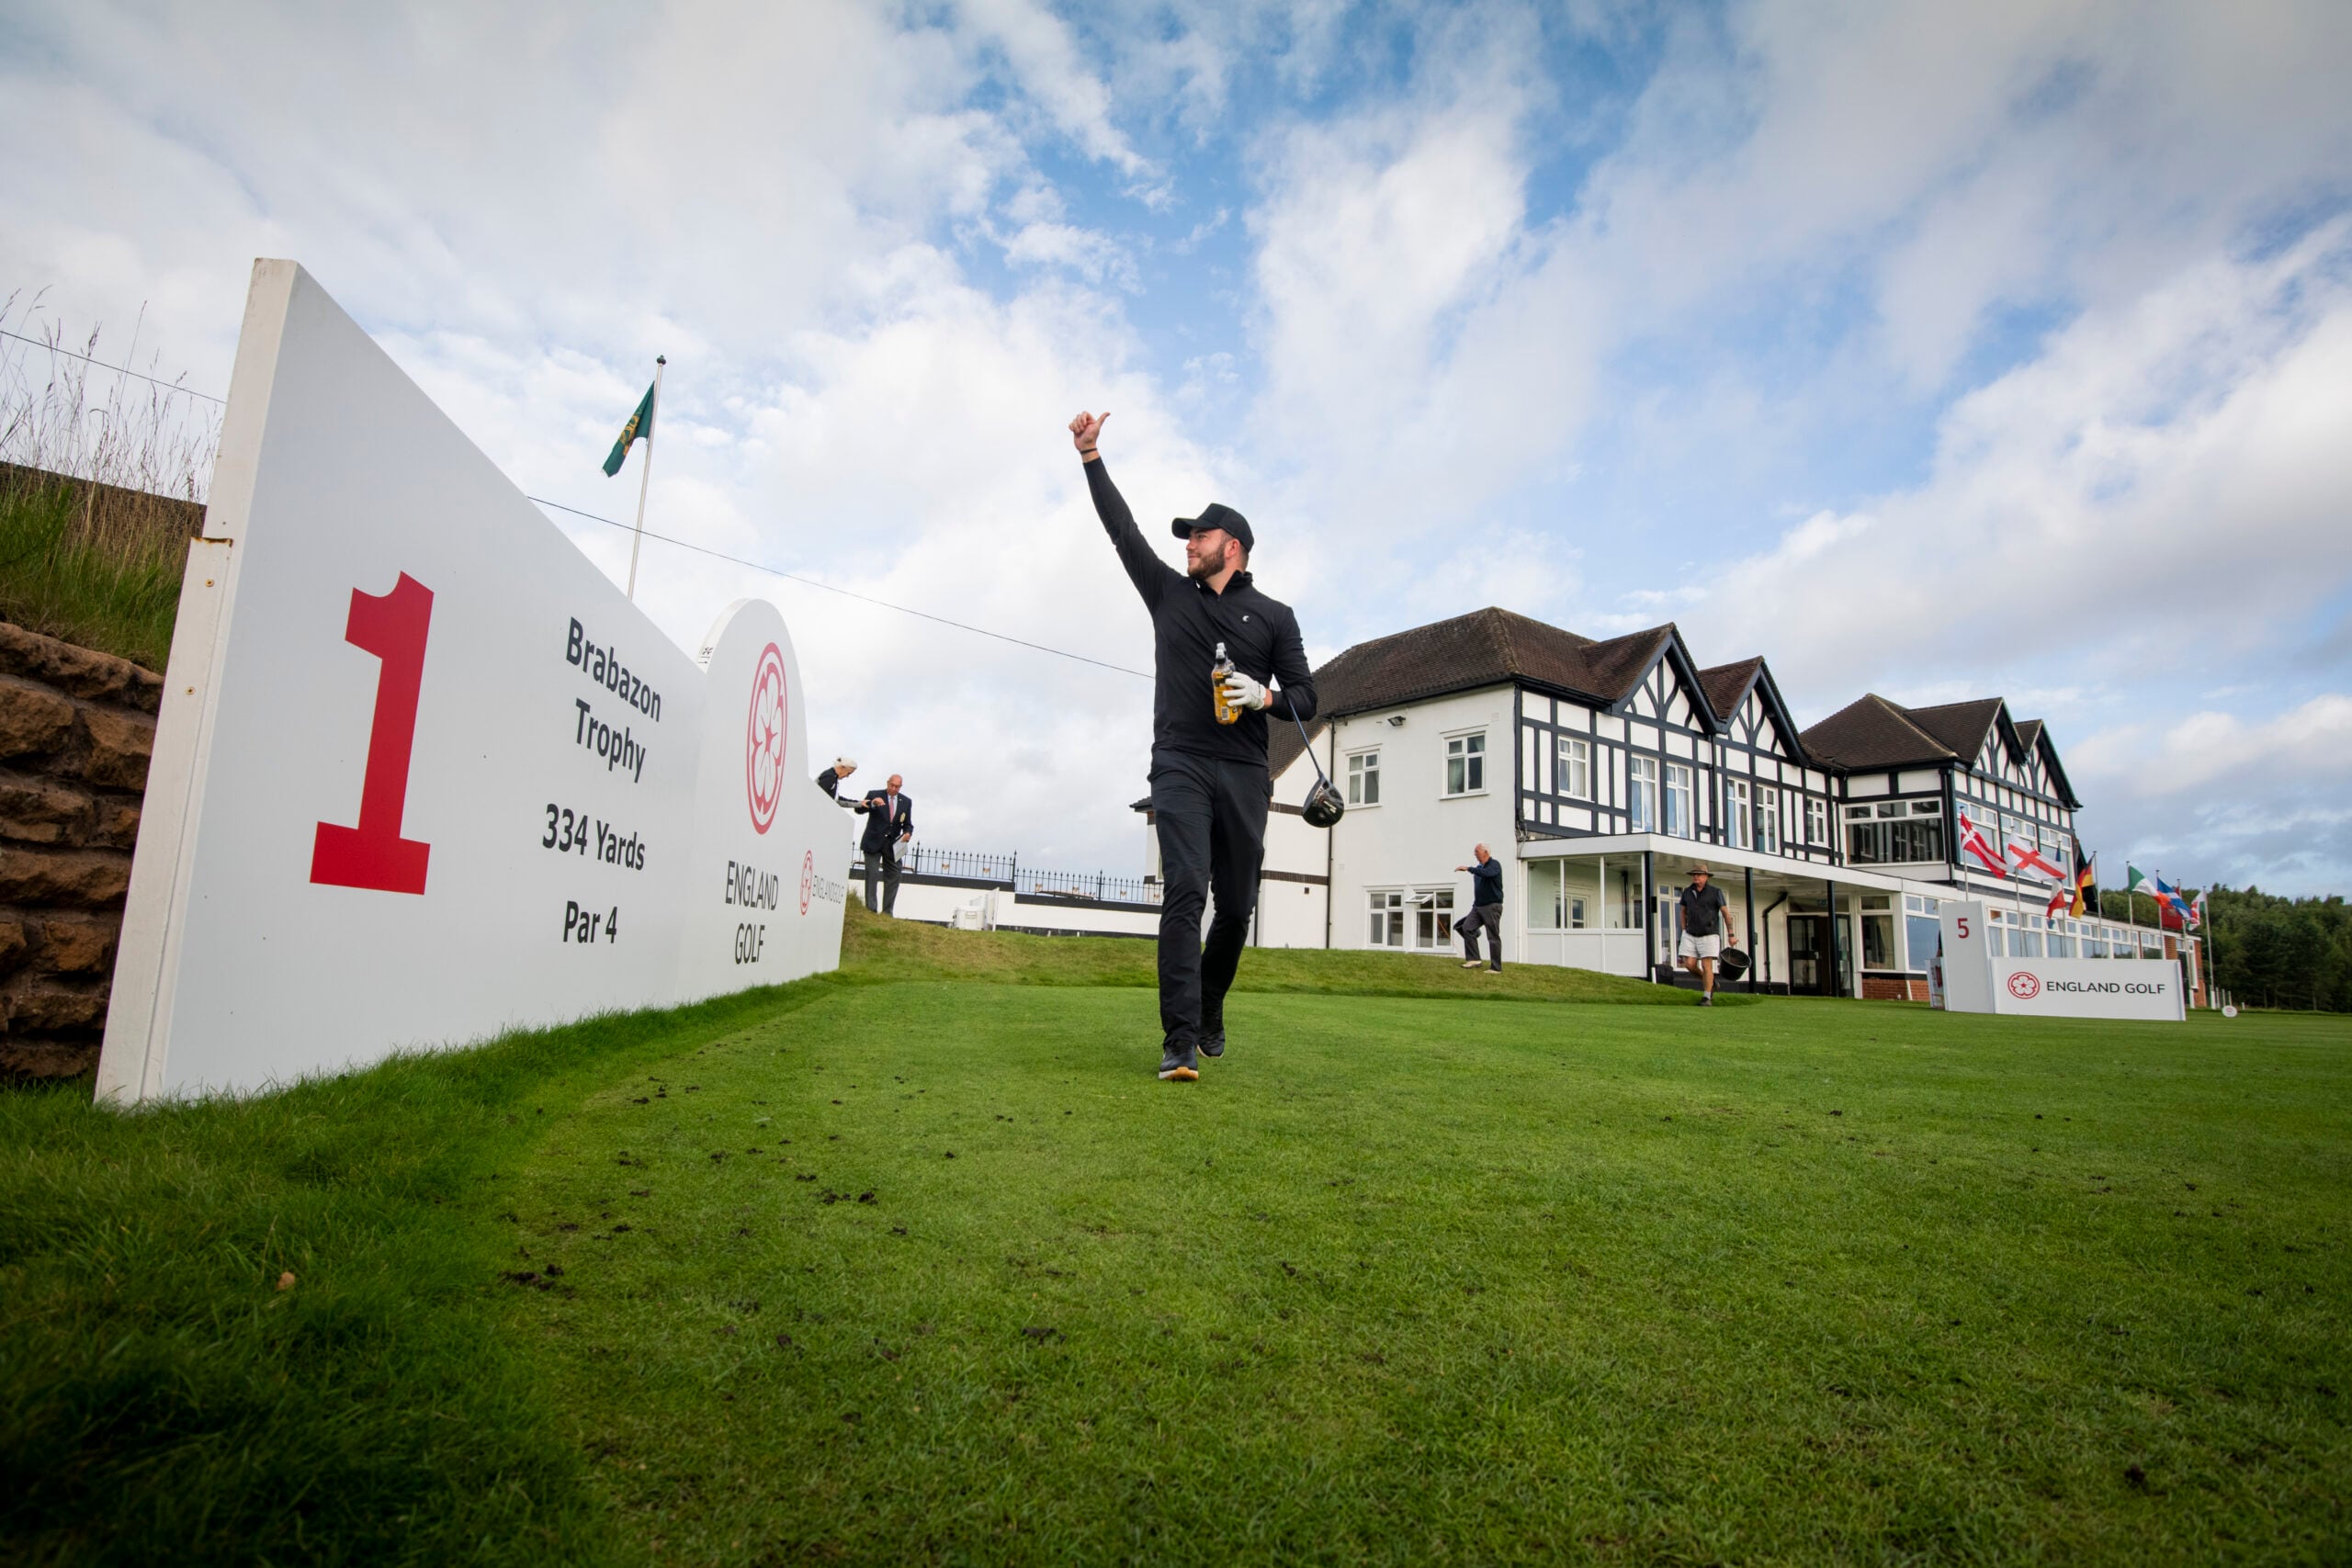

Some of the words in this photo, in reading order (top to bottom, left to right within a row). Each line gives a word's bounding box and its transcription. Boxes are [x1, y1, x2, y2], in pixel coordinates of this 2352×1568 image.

[566, 615, 662, 723] Brabazon
[309, 570, 435, 895] 1
[575, 697, 647, 784] Trophy
[542, 803, 589, 856] 334
[595, 819, 646, 871] Yards
[725, 860, 779, 911] ENGLAND
[562, 900, 601, 944] Par
[605, 906, 618, 944] 4
[735, 922, 765, 964] GOLF
[1957, 917, 1970, 940] 5
[2046, 981, 2120, 994] ENGLAND
[2124, 983, 2166, 995] GOLF
